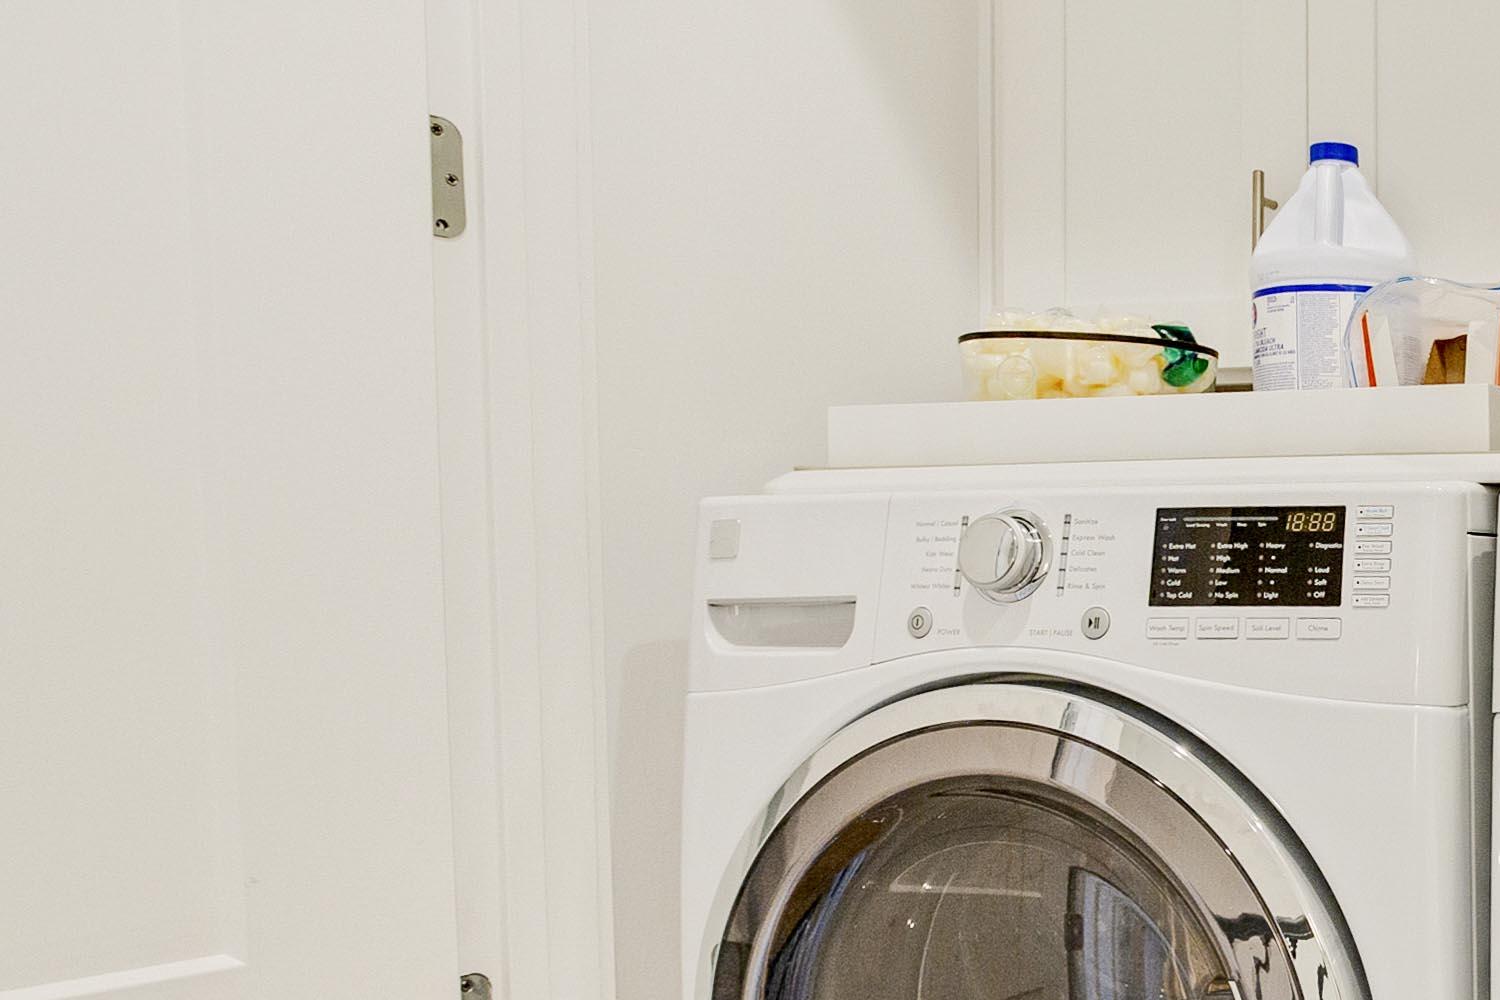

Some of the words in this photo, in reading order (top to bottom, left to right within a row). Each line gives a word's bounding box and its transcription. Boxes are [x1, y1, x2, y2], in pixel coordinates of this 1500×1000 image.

[1285, 512, 1336, 532] 18:88
[1168, 542, 1184, 550] Extra
[1216, 542, 1233, 550] Extra
[1233, 542, 1249, 551] High
[1265, 542, 1286, 550] Heavy
[1215, 554, 1231, 563] High
[1264, 566, 1288, 574] Normal
[1314, 566, 1330, 574] Loud
[1166, 579, 1181, 587] Cold
[1313, 578, 1327, 586] Soft
[1178, 591, 1193, 599] Cold
[1214, 591, 1224, 599] No
[1225, 591, 1239, 600] Spin
[1263, 591, 1279, 600] Light
[1313, 590, 1326, 599] Off
